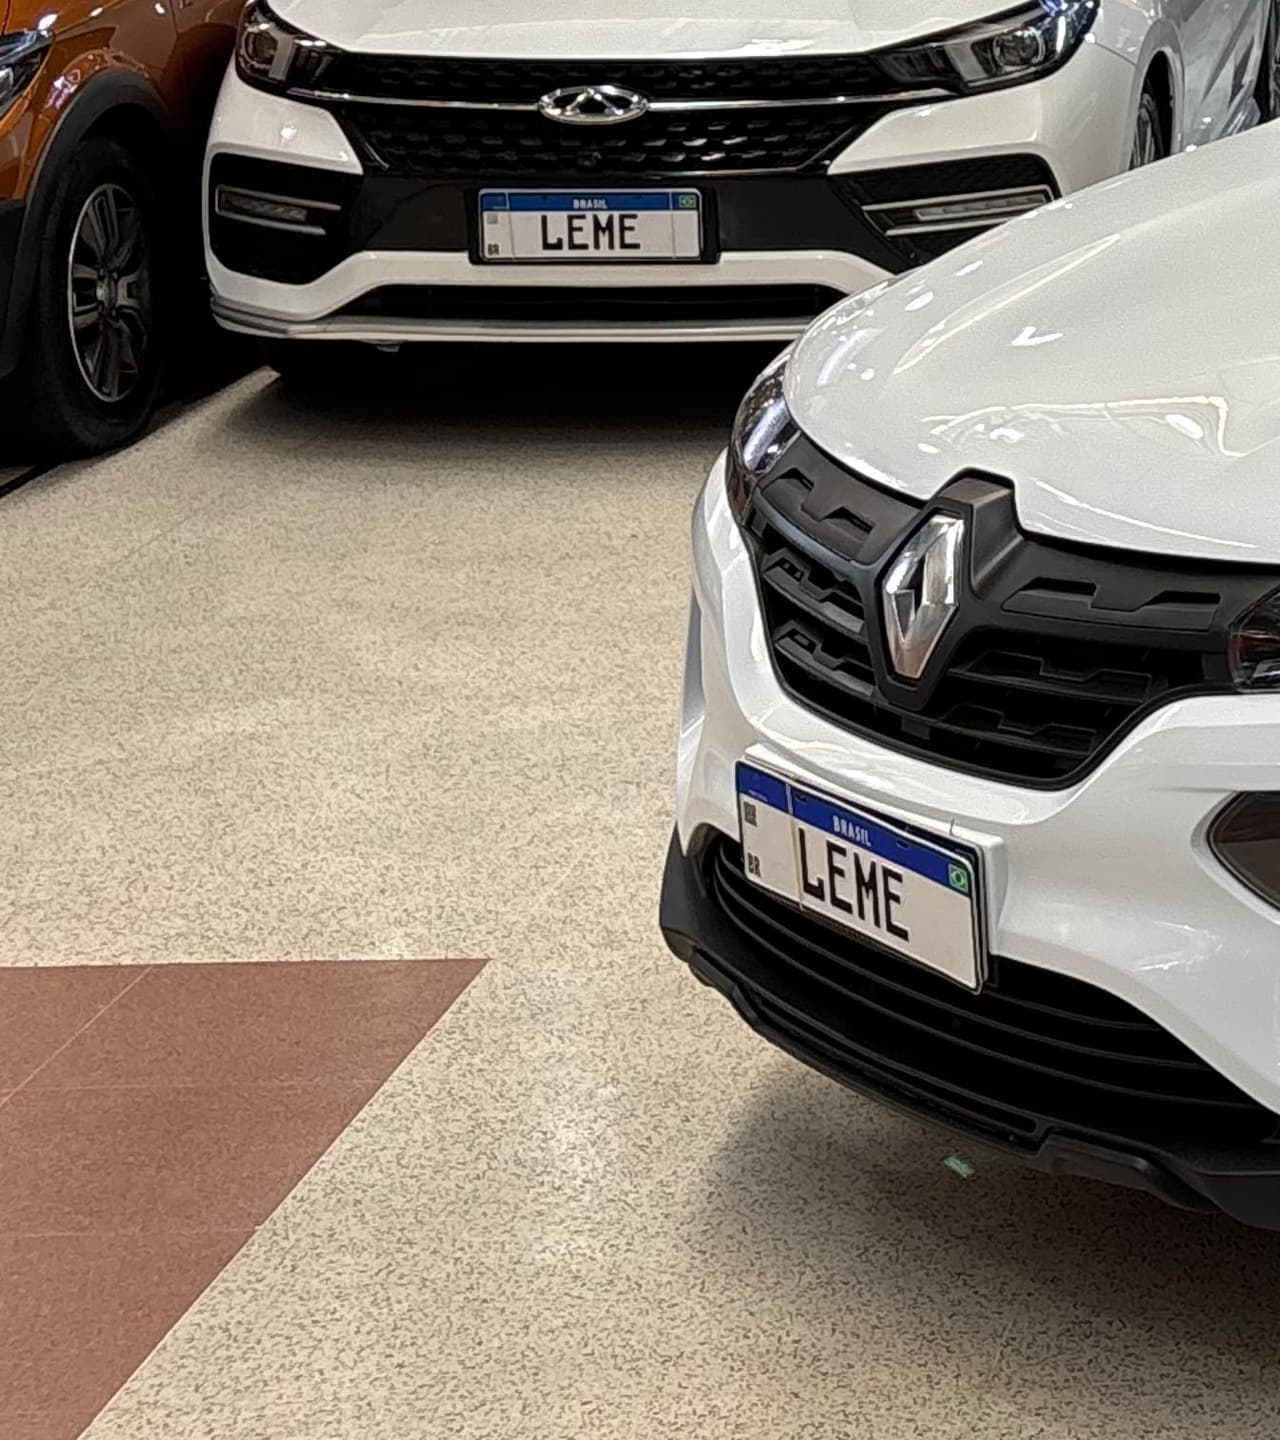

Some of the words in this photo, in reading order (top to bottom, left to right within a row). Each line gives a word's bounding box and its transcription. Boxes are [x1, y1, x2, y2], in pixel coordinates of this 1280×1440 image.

[572, 198, 608, 209] BRASIL
[541, 213, 641, 251] LEME
[832, 814, 872, 847] BRASIL
[798, 826, 910, 943] LEME
